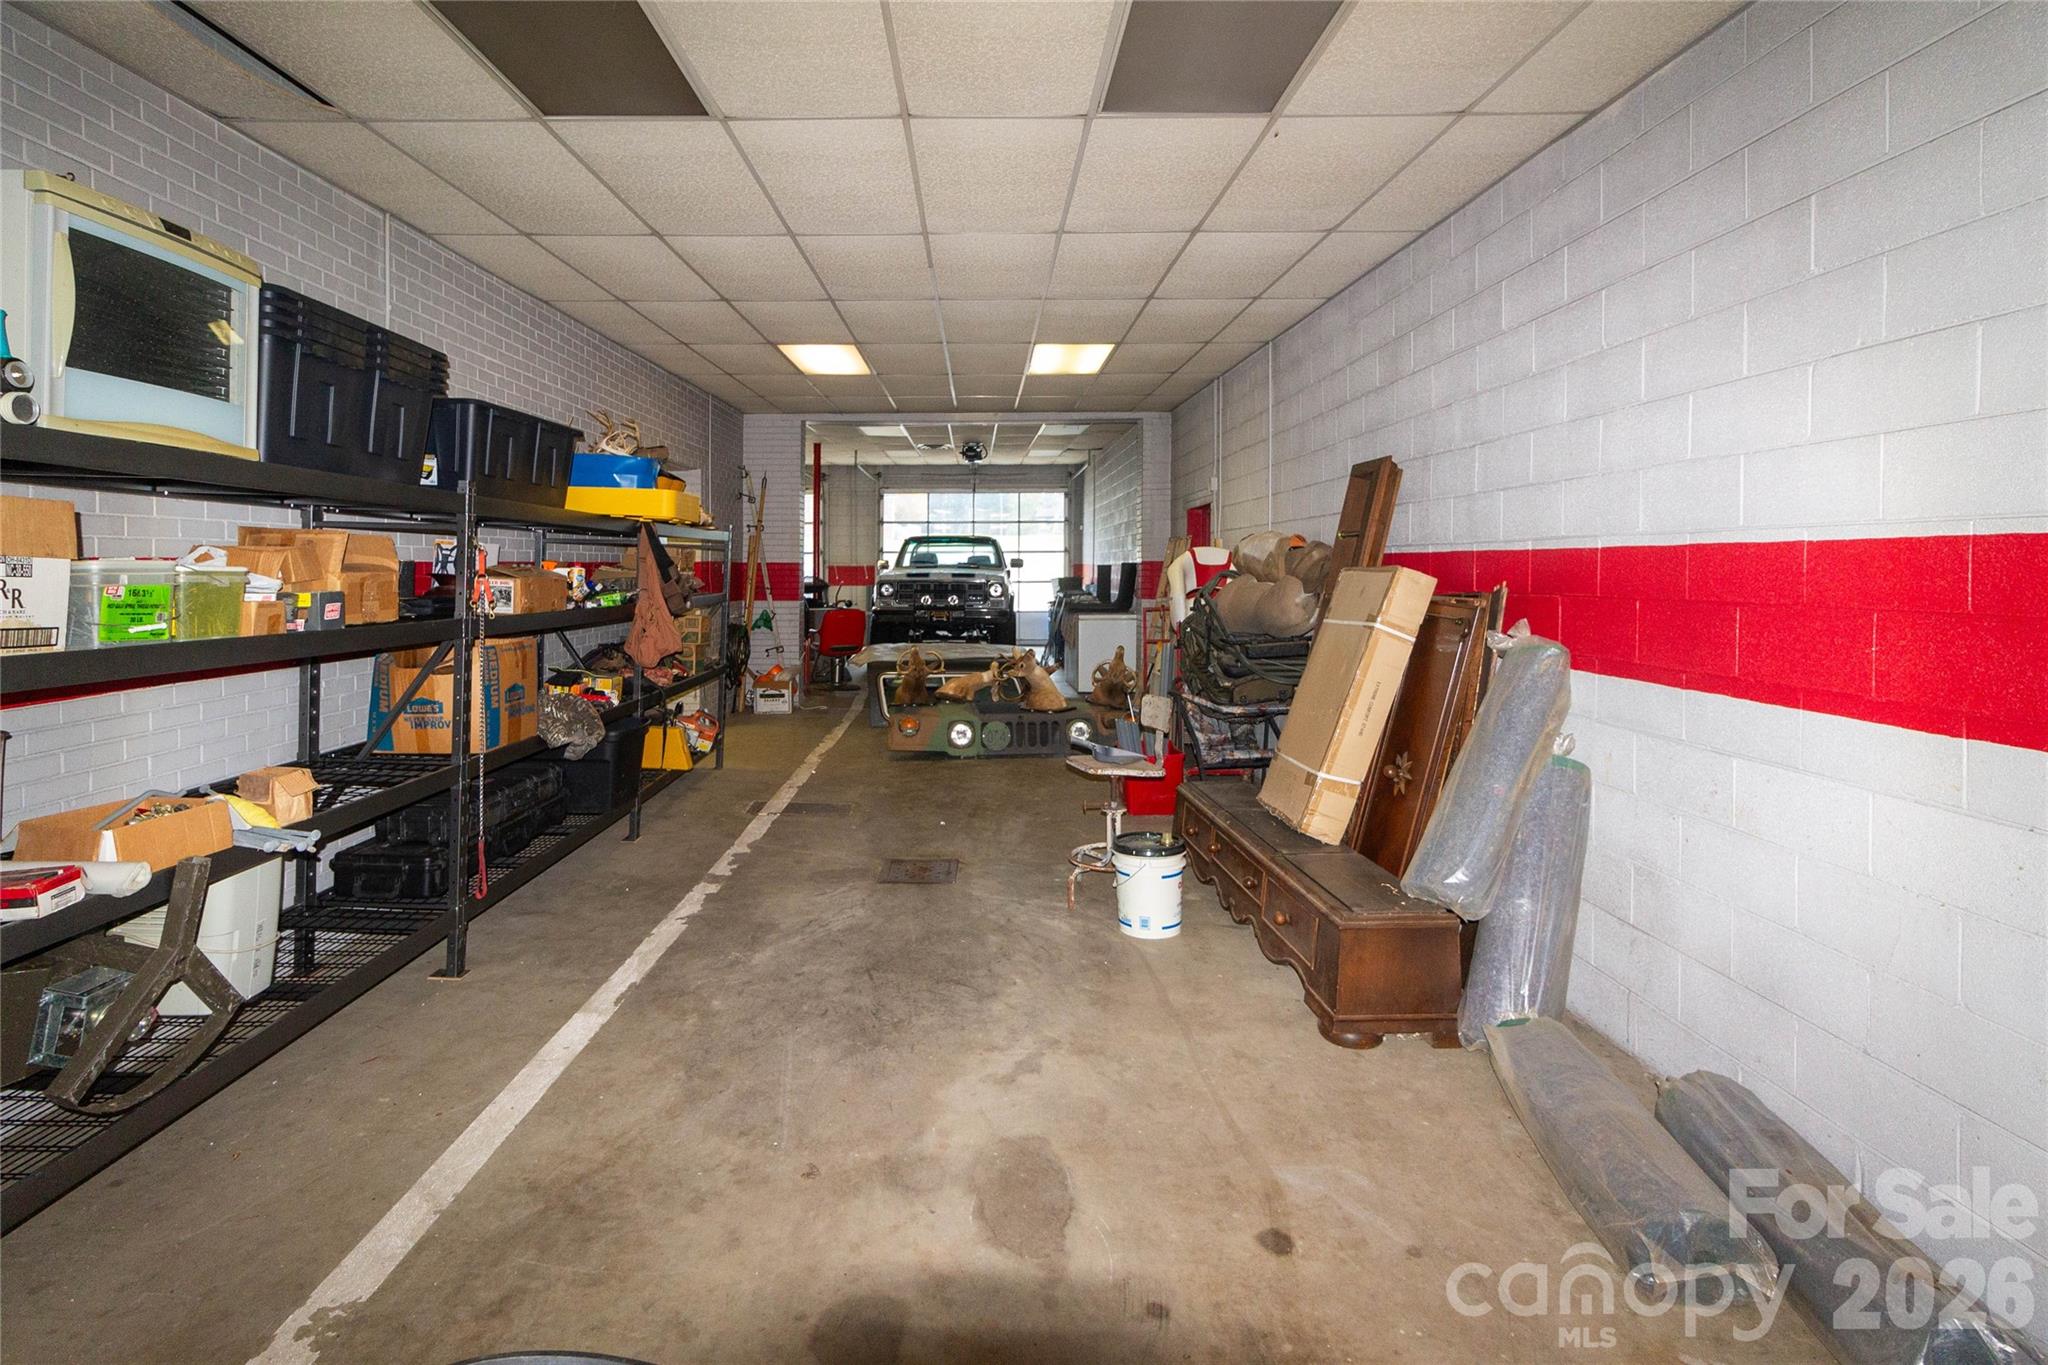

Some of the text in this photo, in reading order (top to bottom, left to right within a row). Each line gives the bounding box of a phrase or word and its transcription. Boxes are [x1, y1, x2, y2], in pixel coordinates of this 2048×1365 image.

[488, 649, 499, 708] MEDIUM
[407, 703, 439, 713] LOWE'S
[409, 719, 452, 729] IMPROV
